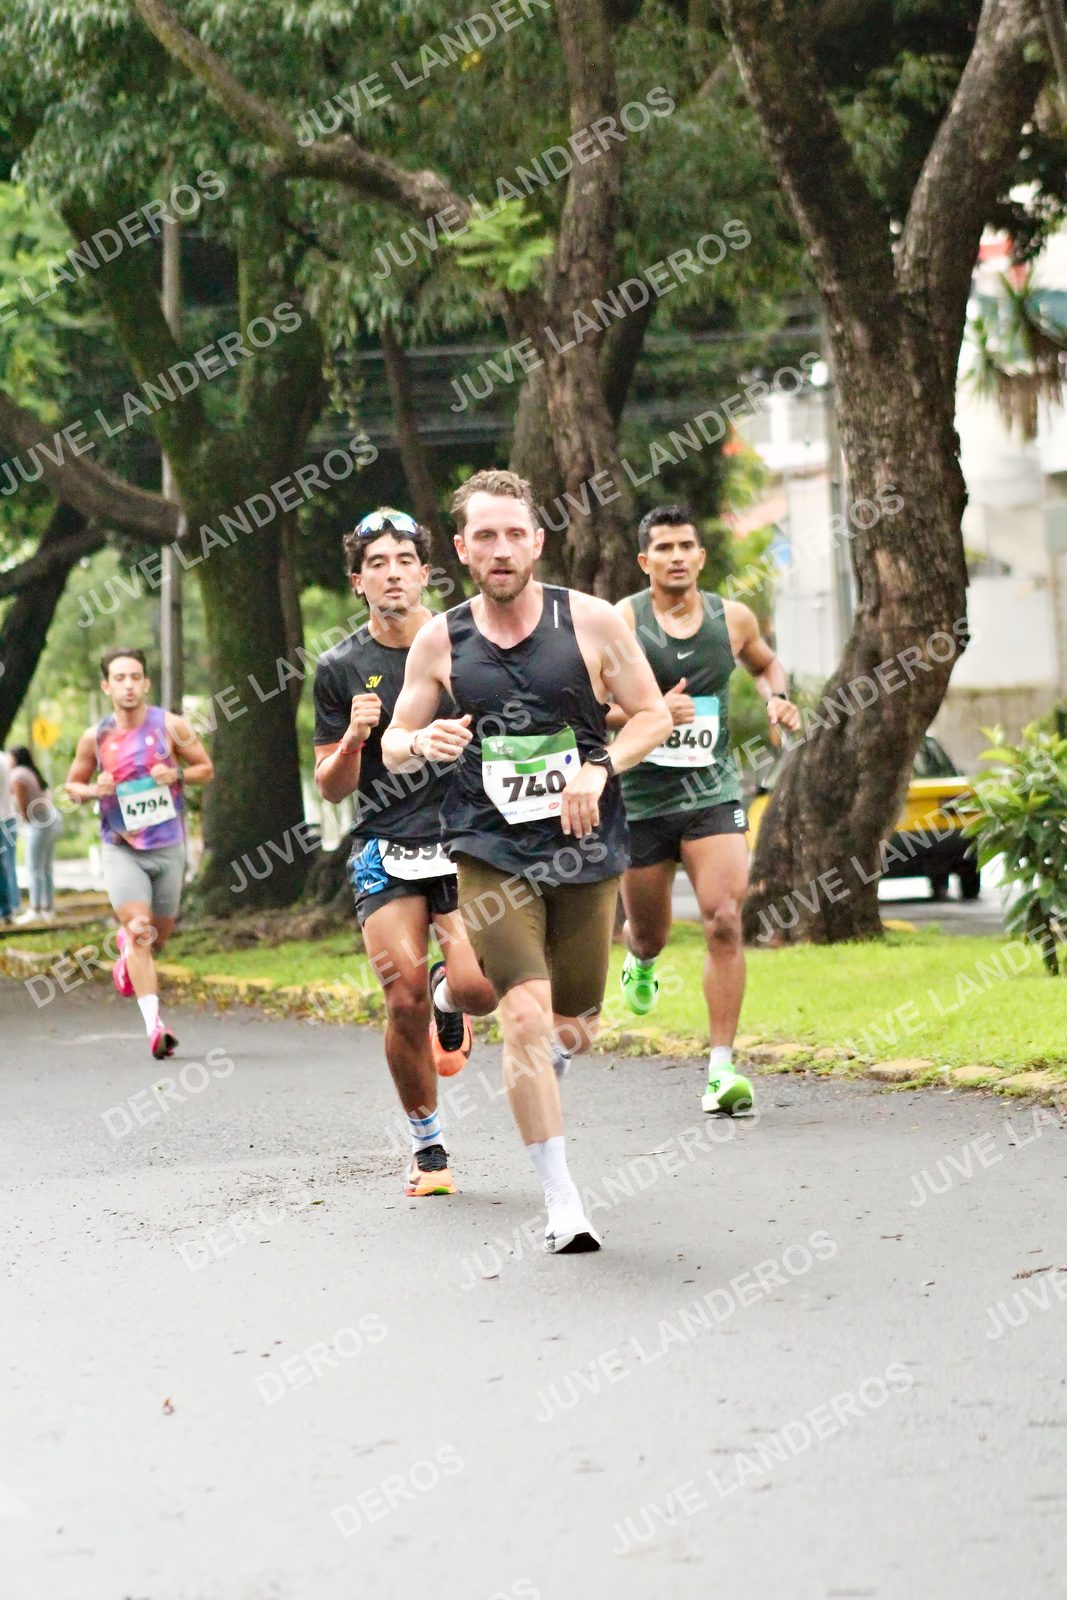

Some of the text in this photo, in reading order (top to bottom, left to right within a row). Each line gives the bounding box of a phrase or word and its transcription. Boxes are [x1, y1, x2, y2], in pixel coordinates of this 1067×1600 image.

[660, 729, 712, 749] 840
[502, 770, 566, 803] 740
[127, 796, 168, 815] 4794
